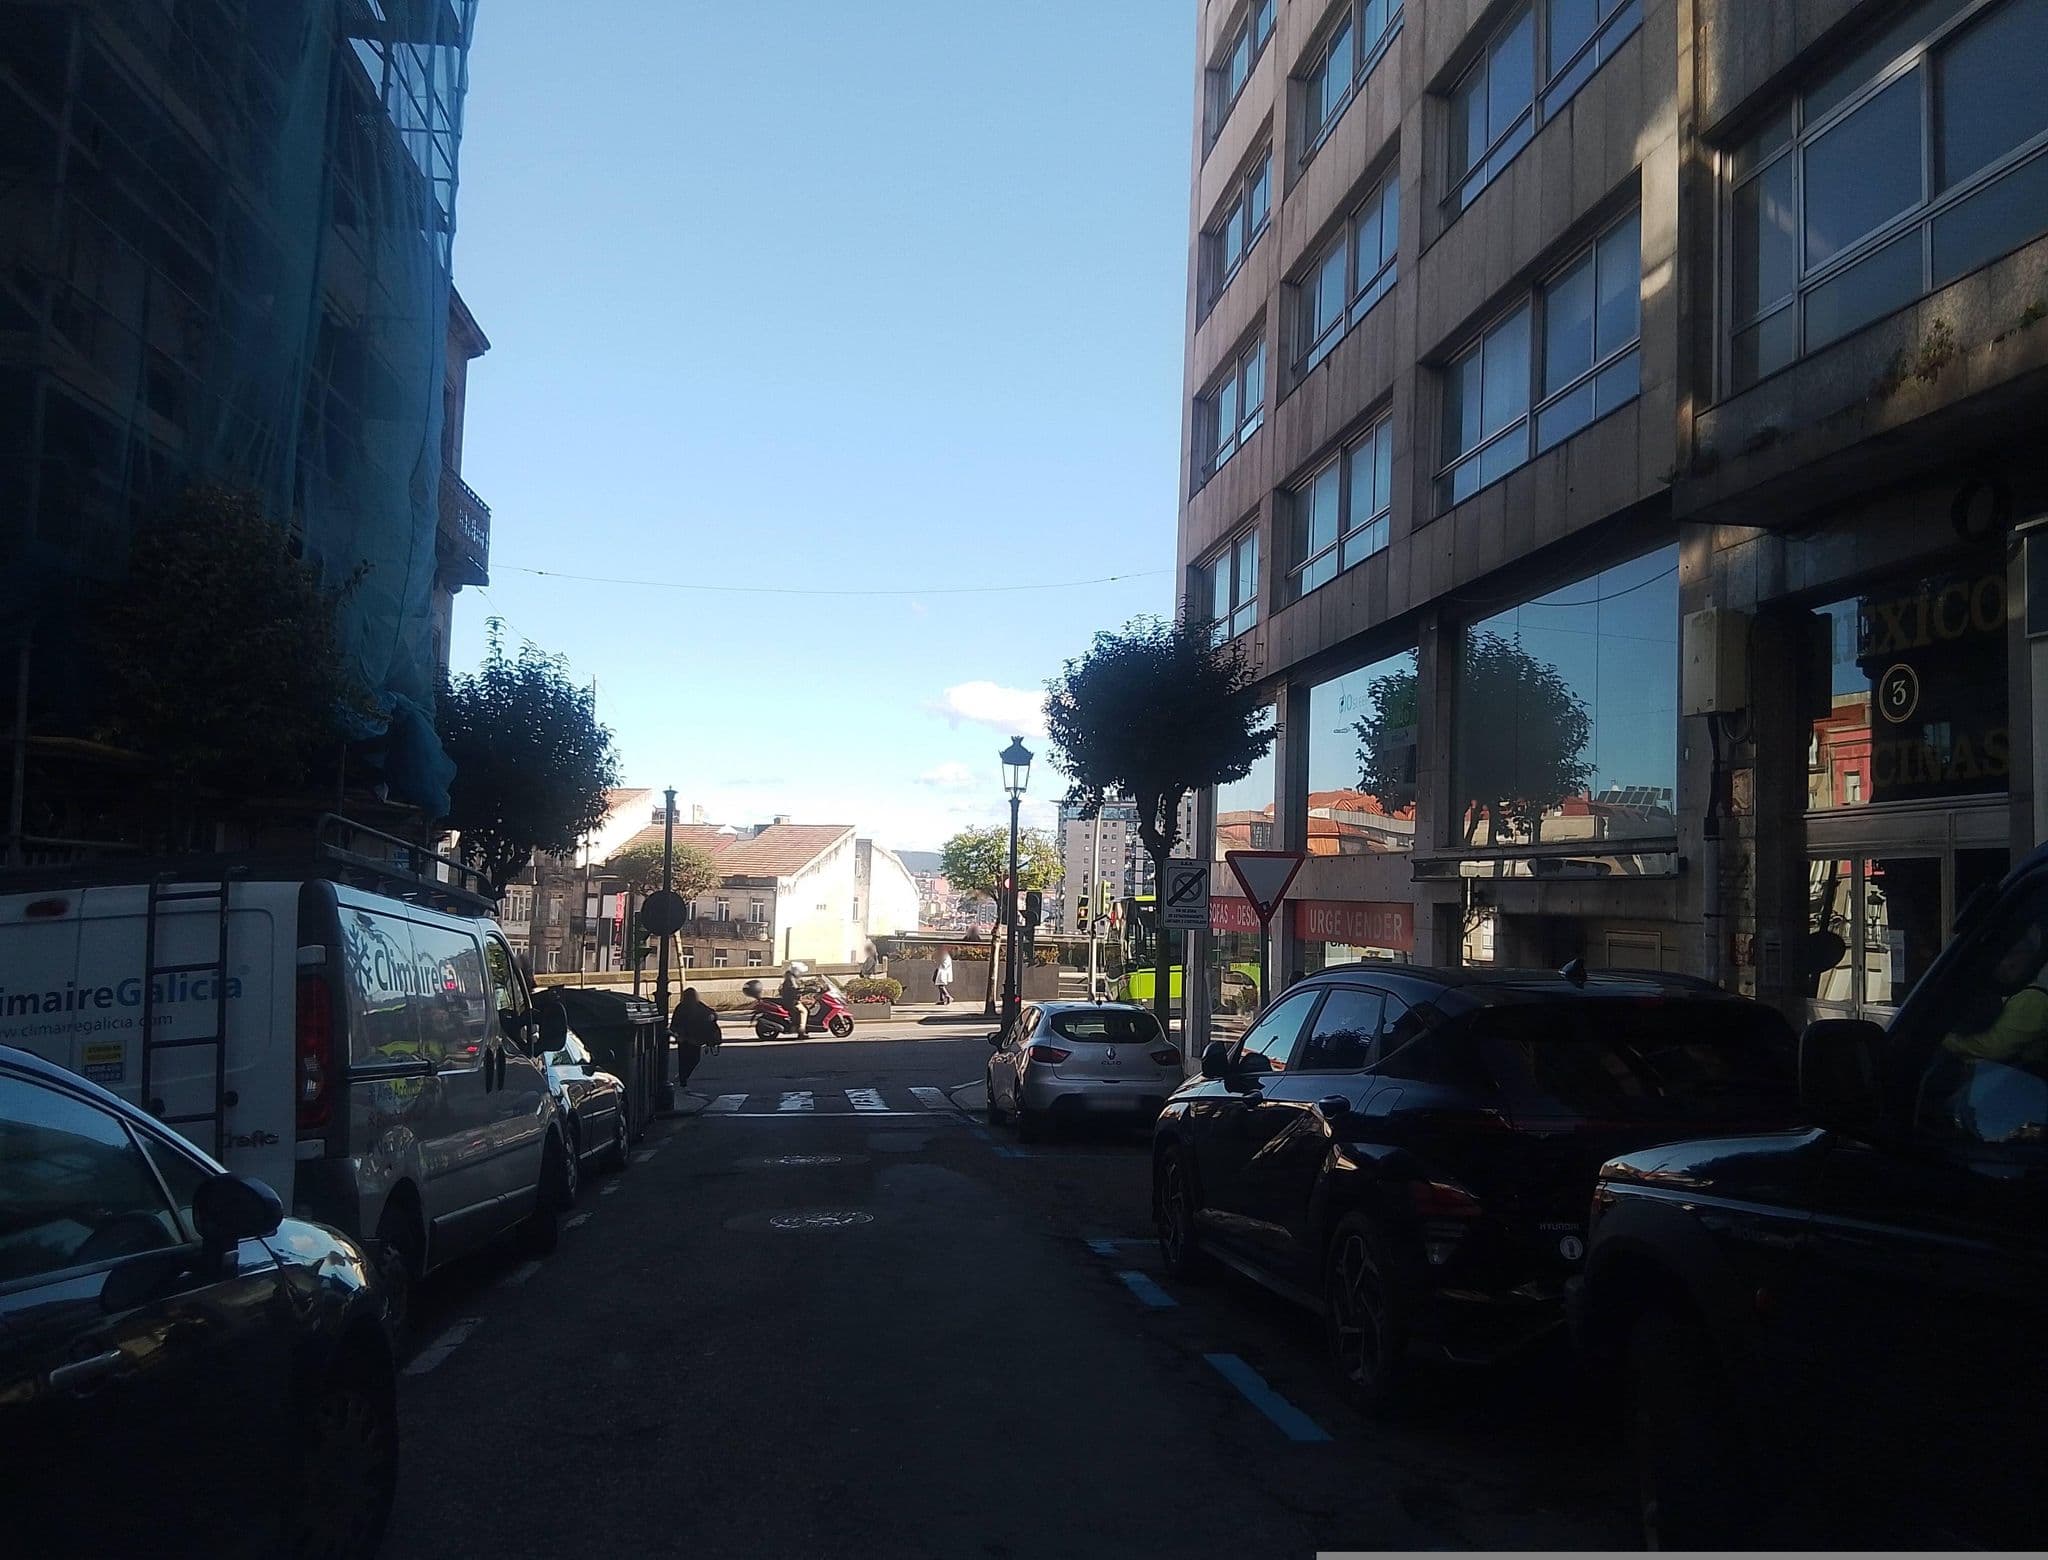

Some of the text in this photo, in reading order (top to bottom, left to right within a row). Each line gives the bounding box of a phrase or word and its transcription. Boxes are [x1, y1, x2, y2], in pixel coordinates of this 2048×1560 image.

[1860, 574, 2007, 656] EXICO
[1891, 680, 1907, 705] 3
[1310, 908, 1402, 941] URGE VENDER
